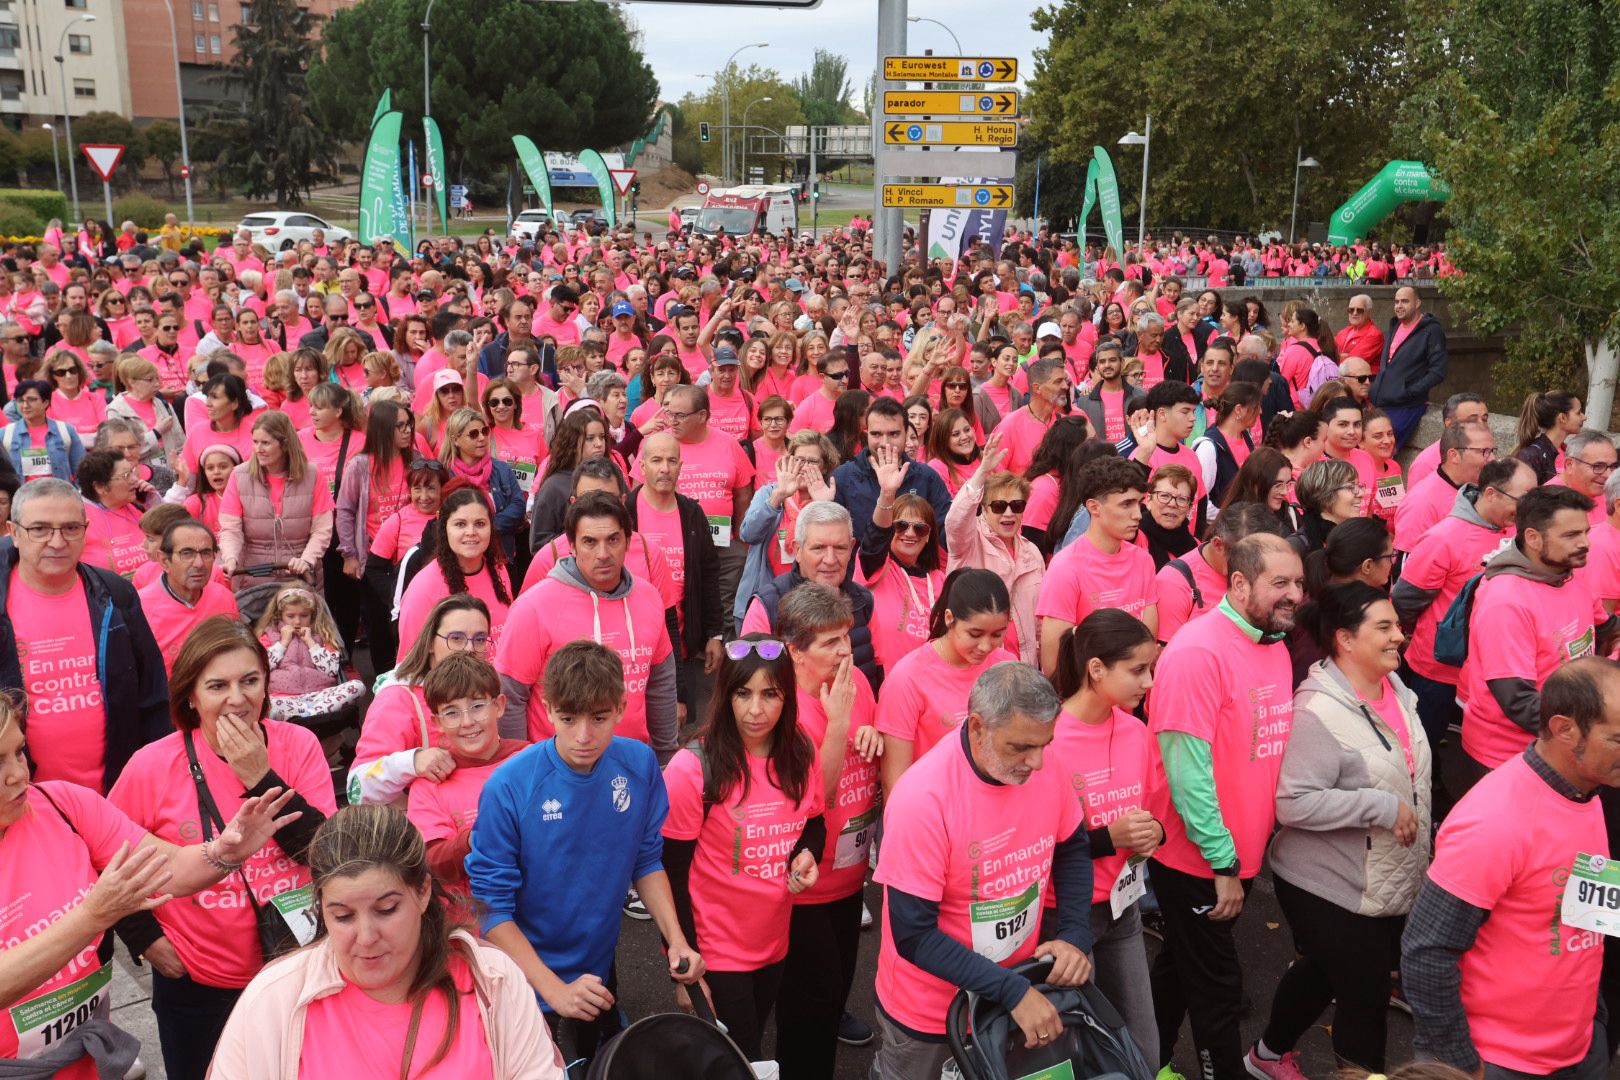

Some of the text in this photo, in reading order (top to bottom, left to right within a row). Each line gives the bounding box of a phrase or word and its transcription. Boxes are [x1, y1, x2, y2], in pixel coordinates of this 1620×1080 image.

[886, 61, 947, 70] H. Eurowest
[887, 100, 926, 108] parador
[987, 126, 1013, 134] Horus
[988, 135, 1013, 144] Regio
[1394, 178, 1418, 186] contra
[897, 188, 923, 196] Vincci
[909, 197, 944, 205] Romano
[693, 471, 729, 479] marcha
[679, 480, 716, 489] contra
[113, 548, 128, 557] En
[29, 659, 54, 675] En
[30, 672, 100, 693] contra
[840, 765, 877, 789] contra
[1088, 791, 1105, 807] En
[746, 824, 765, 840] En
[983, 860, 1002, 876] En
[1004, 834, 1055, 867] marcha
[983, 864, 1041, 895] contra
[1578, 880, 1620, 910] 9719
[995, 909, 1028, 940] 6127
[20, 997, 58, 1016] Salamanca
[22, 1008, 44, 1022] contra
[41, 995, 100, 1046] 11209
